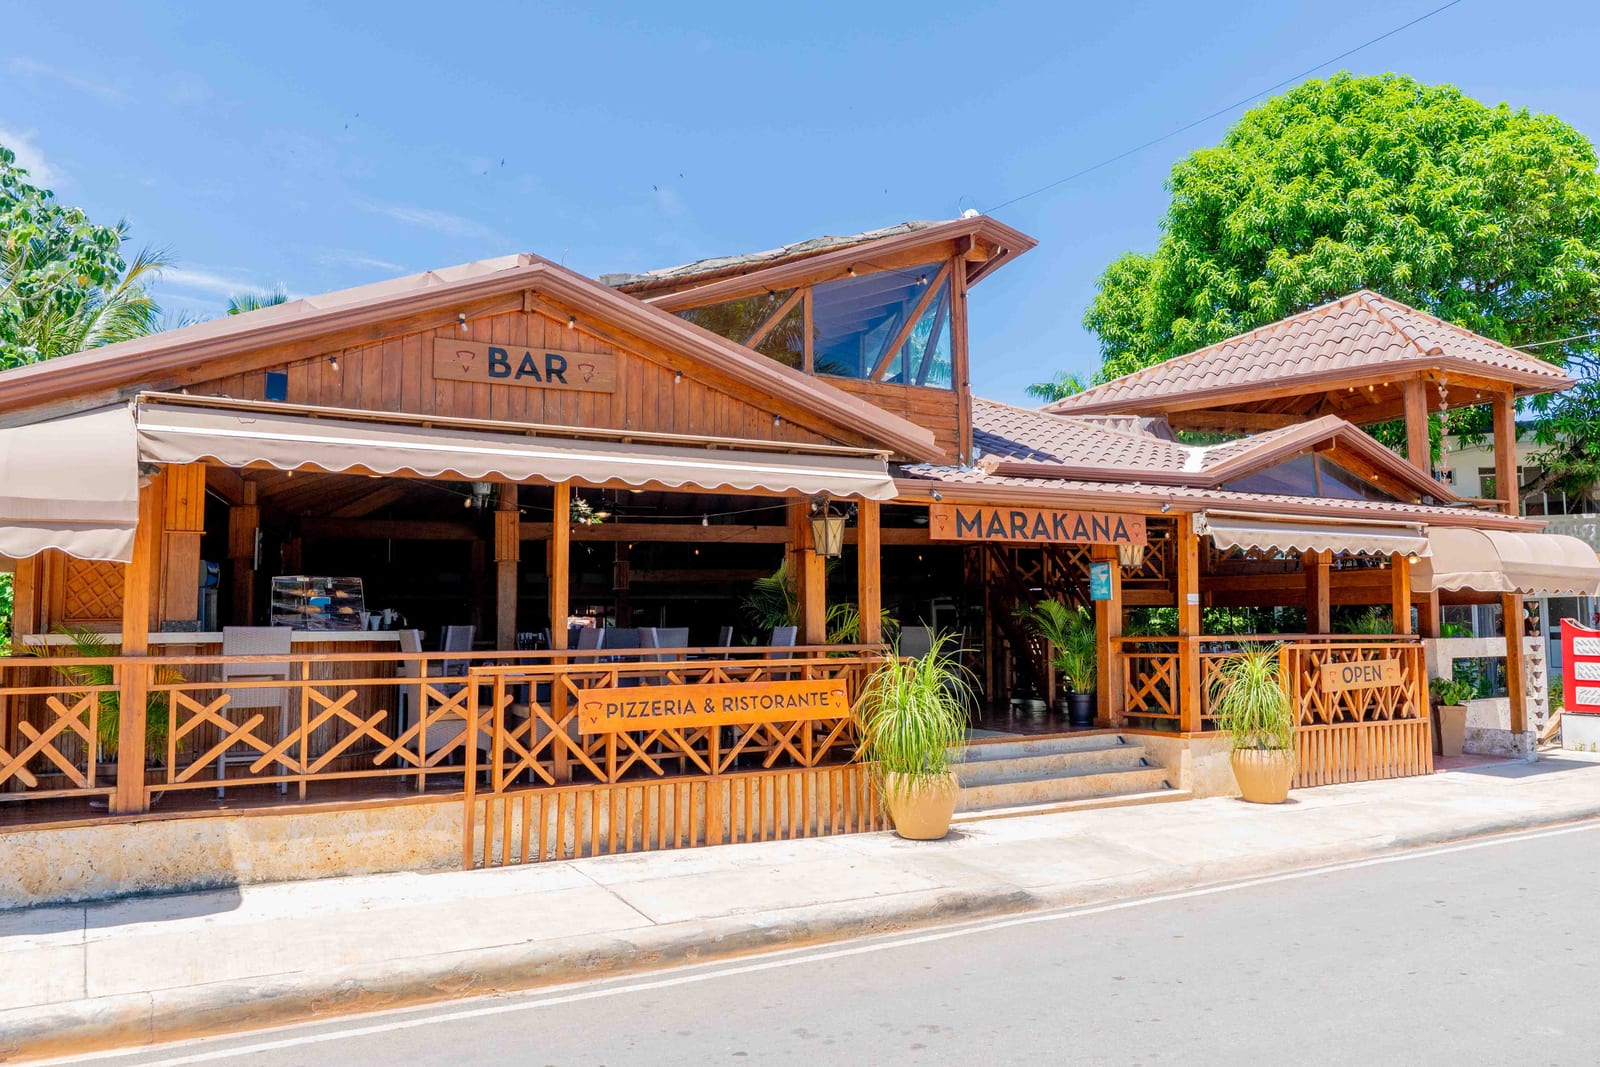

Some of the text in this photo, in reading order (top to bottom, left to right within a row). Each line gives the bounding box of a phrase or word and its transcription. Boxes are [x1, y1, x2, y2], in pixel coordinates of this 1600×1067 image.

[488, 347, 568, 384] BAR
[956, 508, 1131, 542] MARAKANA
[1342, 665, 1382, 683] OPEN
[606, 691, 829, 718] PIZZERIA & RISTORANTE
